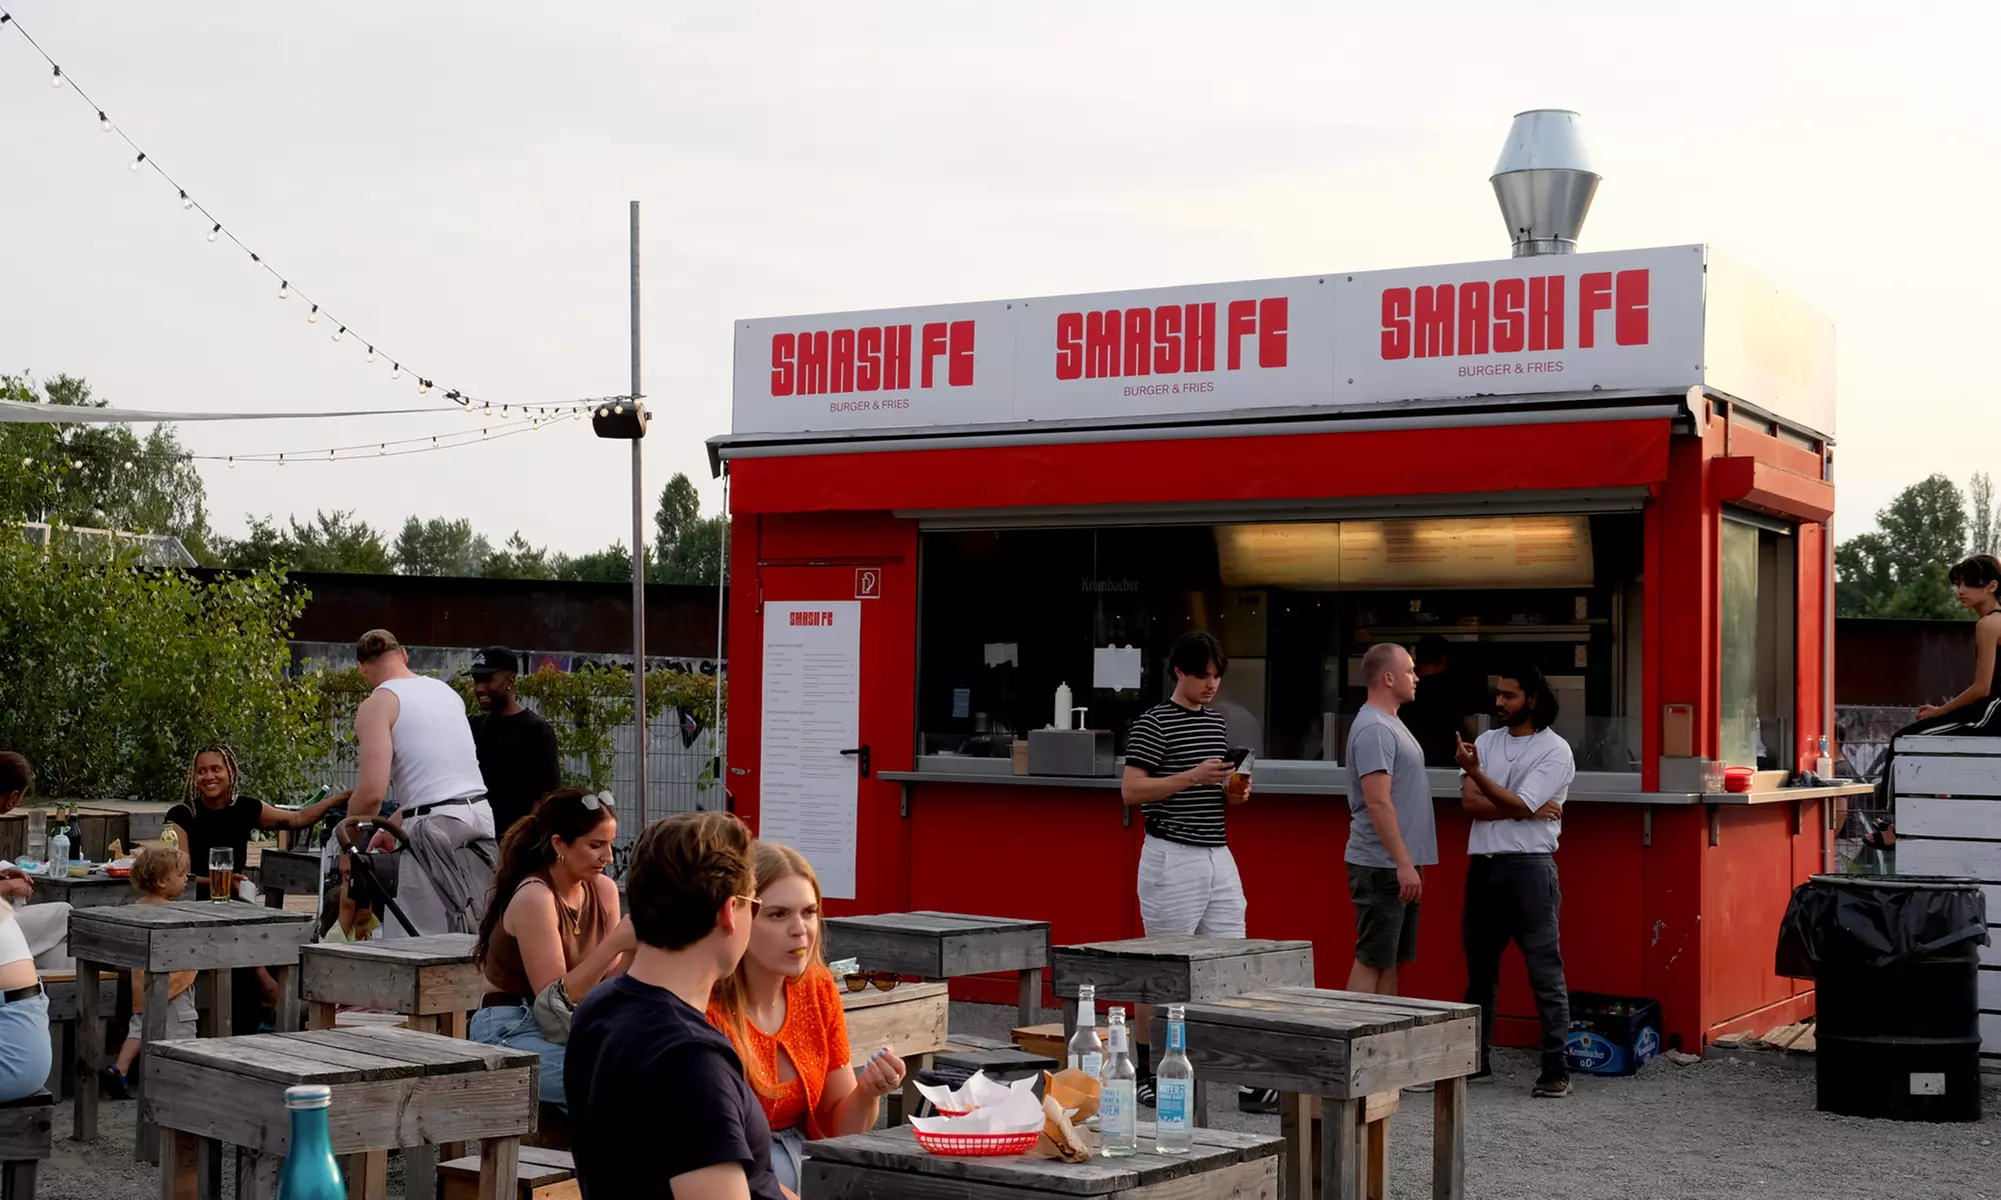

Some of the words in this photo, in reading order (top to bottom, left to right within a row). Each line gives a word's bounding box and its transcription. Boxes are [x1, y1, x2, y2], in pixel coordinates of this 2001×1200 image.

[1381, 275, 1565, 360] SMASH
[1579, 268, 1649, 349] FC
[1056, 302, 1216, 380] SMASH
[1227, 296, 1288, 370] FC
[771, 324, 912, 396] SMASH
[921, 320, 975, 388] FC
[1458, 364, 1511, 377] BURGER
[1514, 363, 1524, 374] &
[1527, 361, 1564, 373] FRIES
[1124, 384, 1169, 397] BURGER
[1172, 383, 1180, 394] &
[1183, 382, 1214, 393] FRIES
[830, 401, 870, 412] BURGER
[872, 401, 880, 410] &
[882, 399, 909, 410] FRIES
[1082, 577, 1140, 592] Krombacher
[790, 611, 820, 626] SMASH
